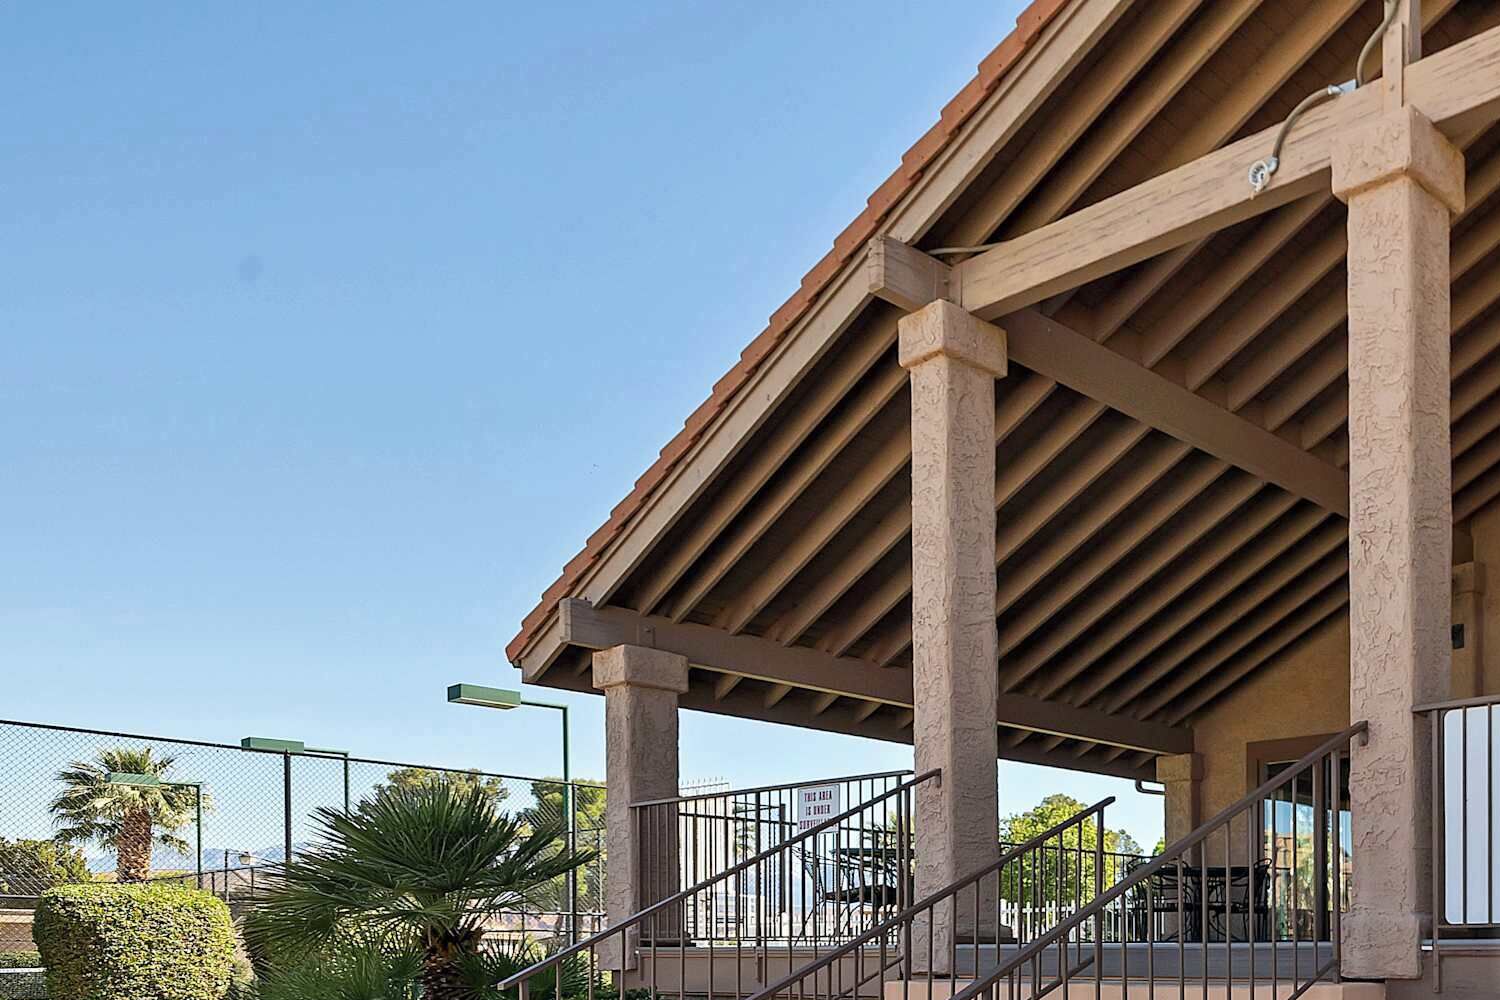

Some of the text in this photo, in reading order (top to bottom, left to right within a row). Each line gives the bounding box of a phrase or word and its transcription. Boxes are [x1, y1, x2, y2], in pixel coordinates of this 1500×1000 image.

[804, 790, 832, 802] THIS AREA
[806, 804, 830, 816] IS UNDER
